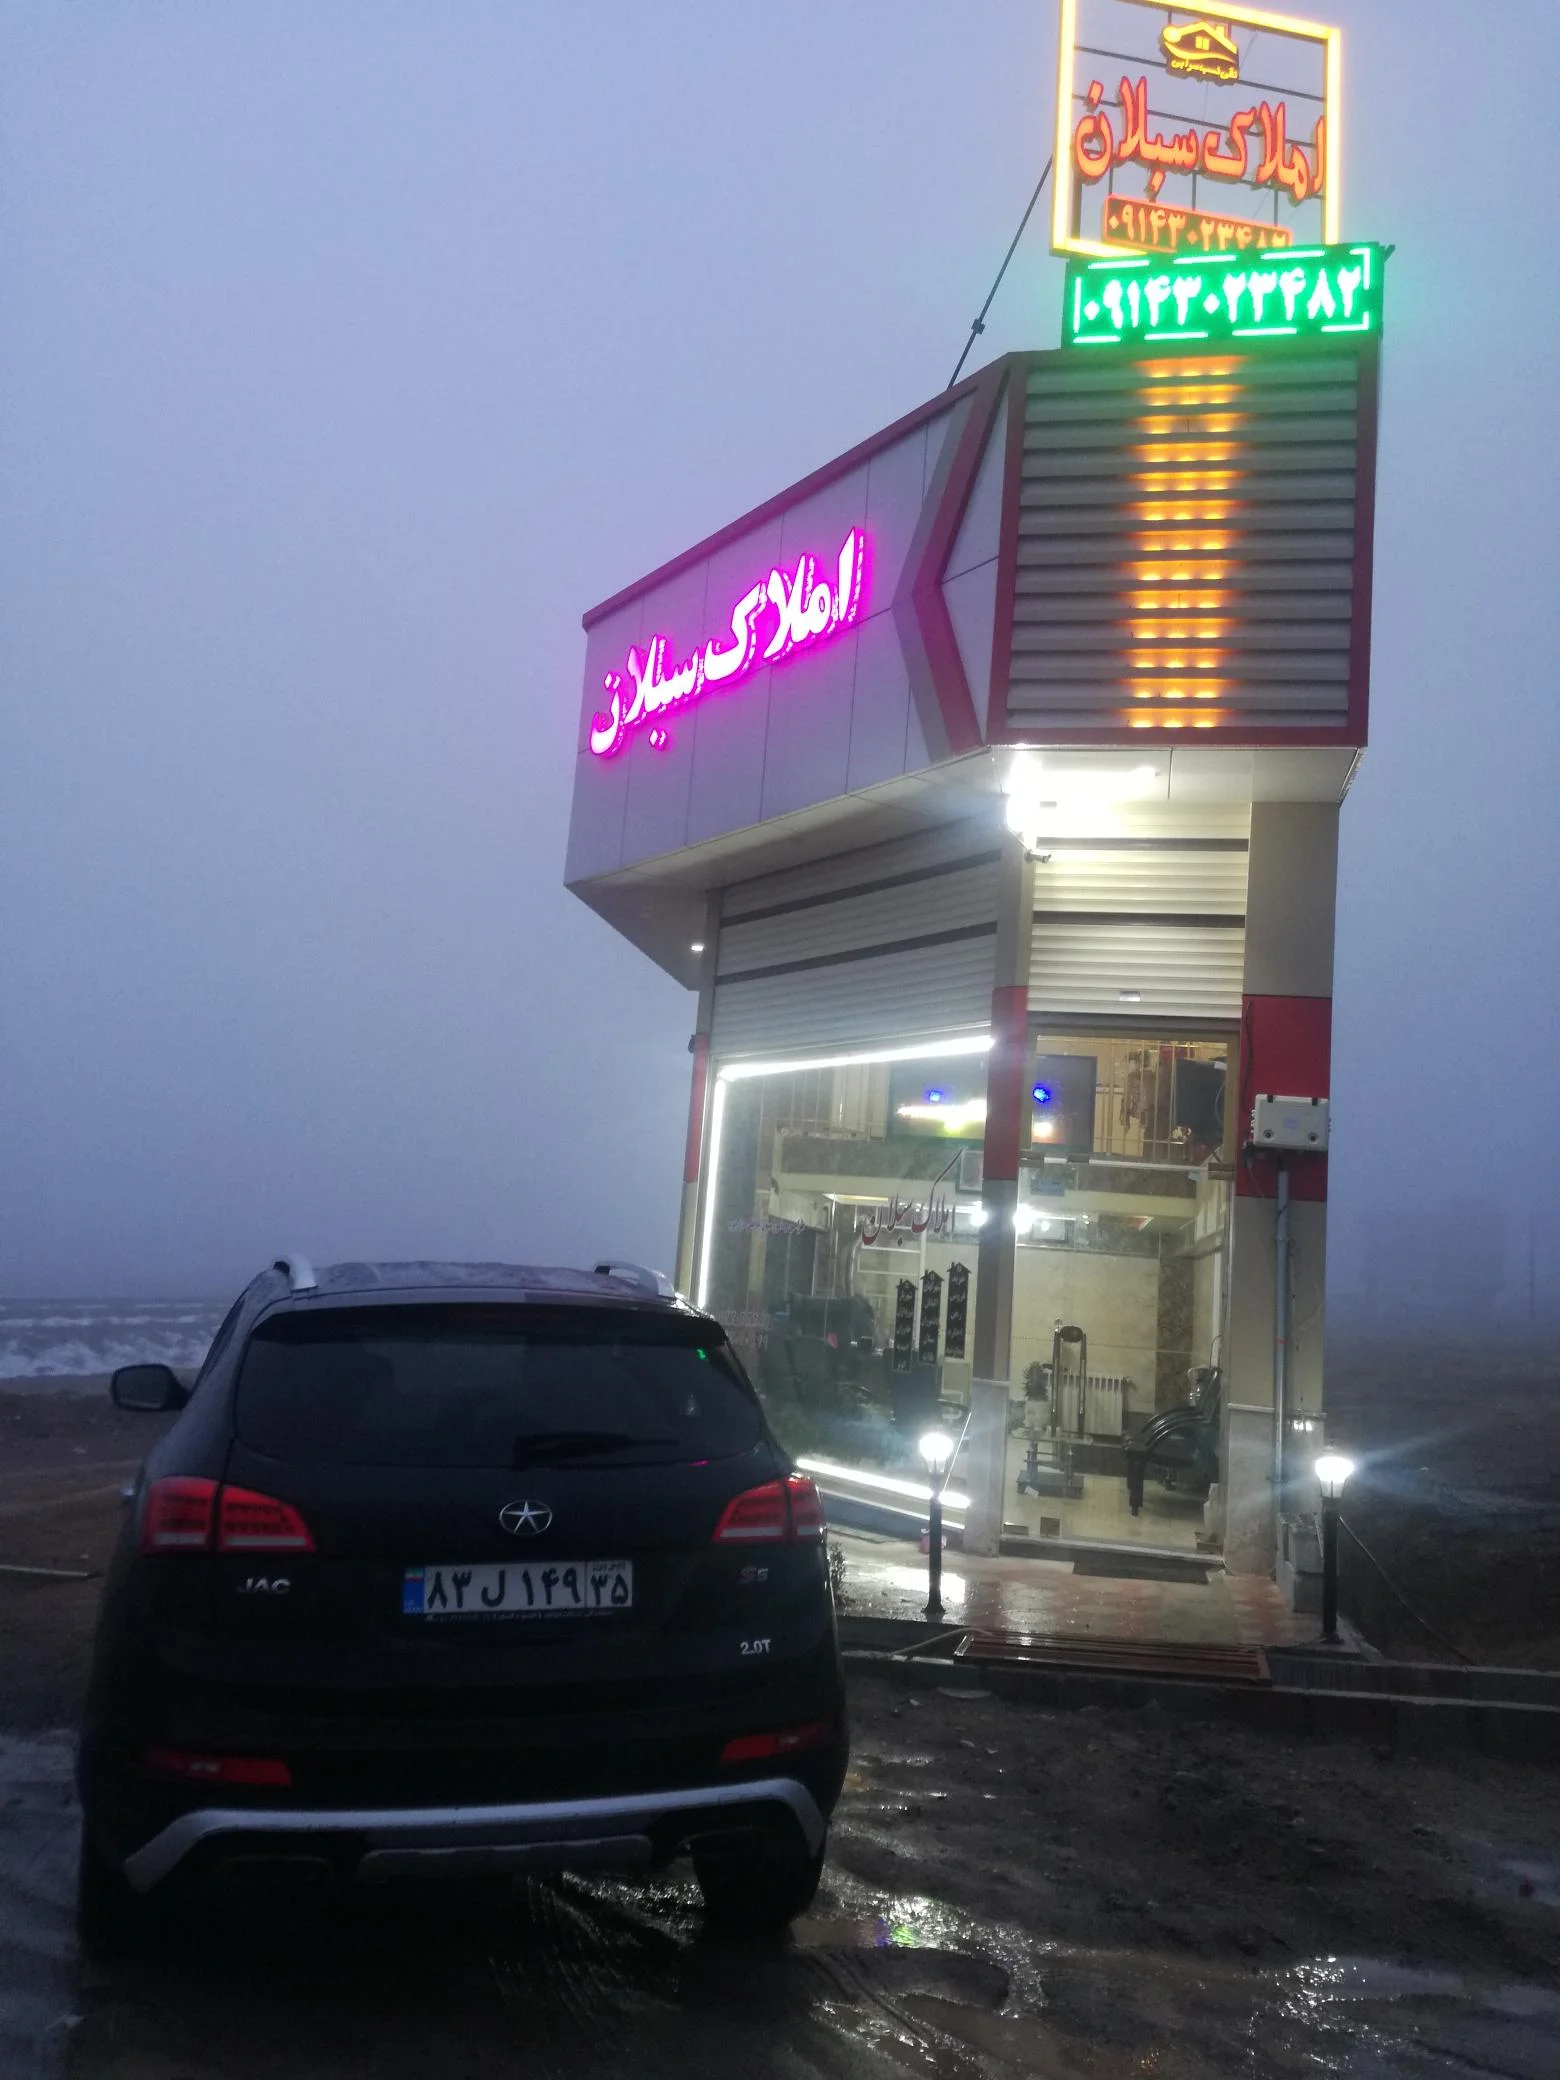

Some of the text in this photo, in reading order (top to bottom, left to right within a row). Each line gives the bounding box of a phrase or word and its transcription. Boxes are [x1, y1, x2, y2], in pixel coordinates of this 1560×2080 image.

[1074, 75, 1325, 200] املاک سبلان
[1084, 267, 1362, 330] ۰۹۱۴۳۰۲۳۴۸۲
[590, 526, 860, 756] املاک سبلان
[236, 1577, 291, 1594] JAC
[590, 1573, 629, 1606] ۳۵
[740, 1638, 771, 1655] 2.0T
